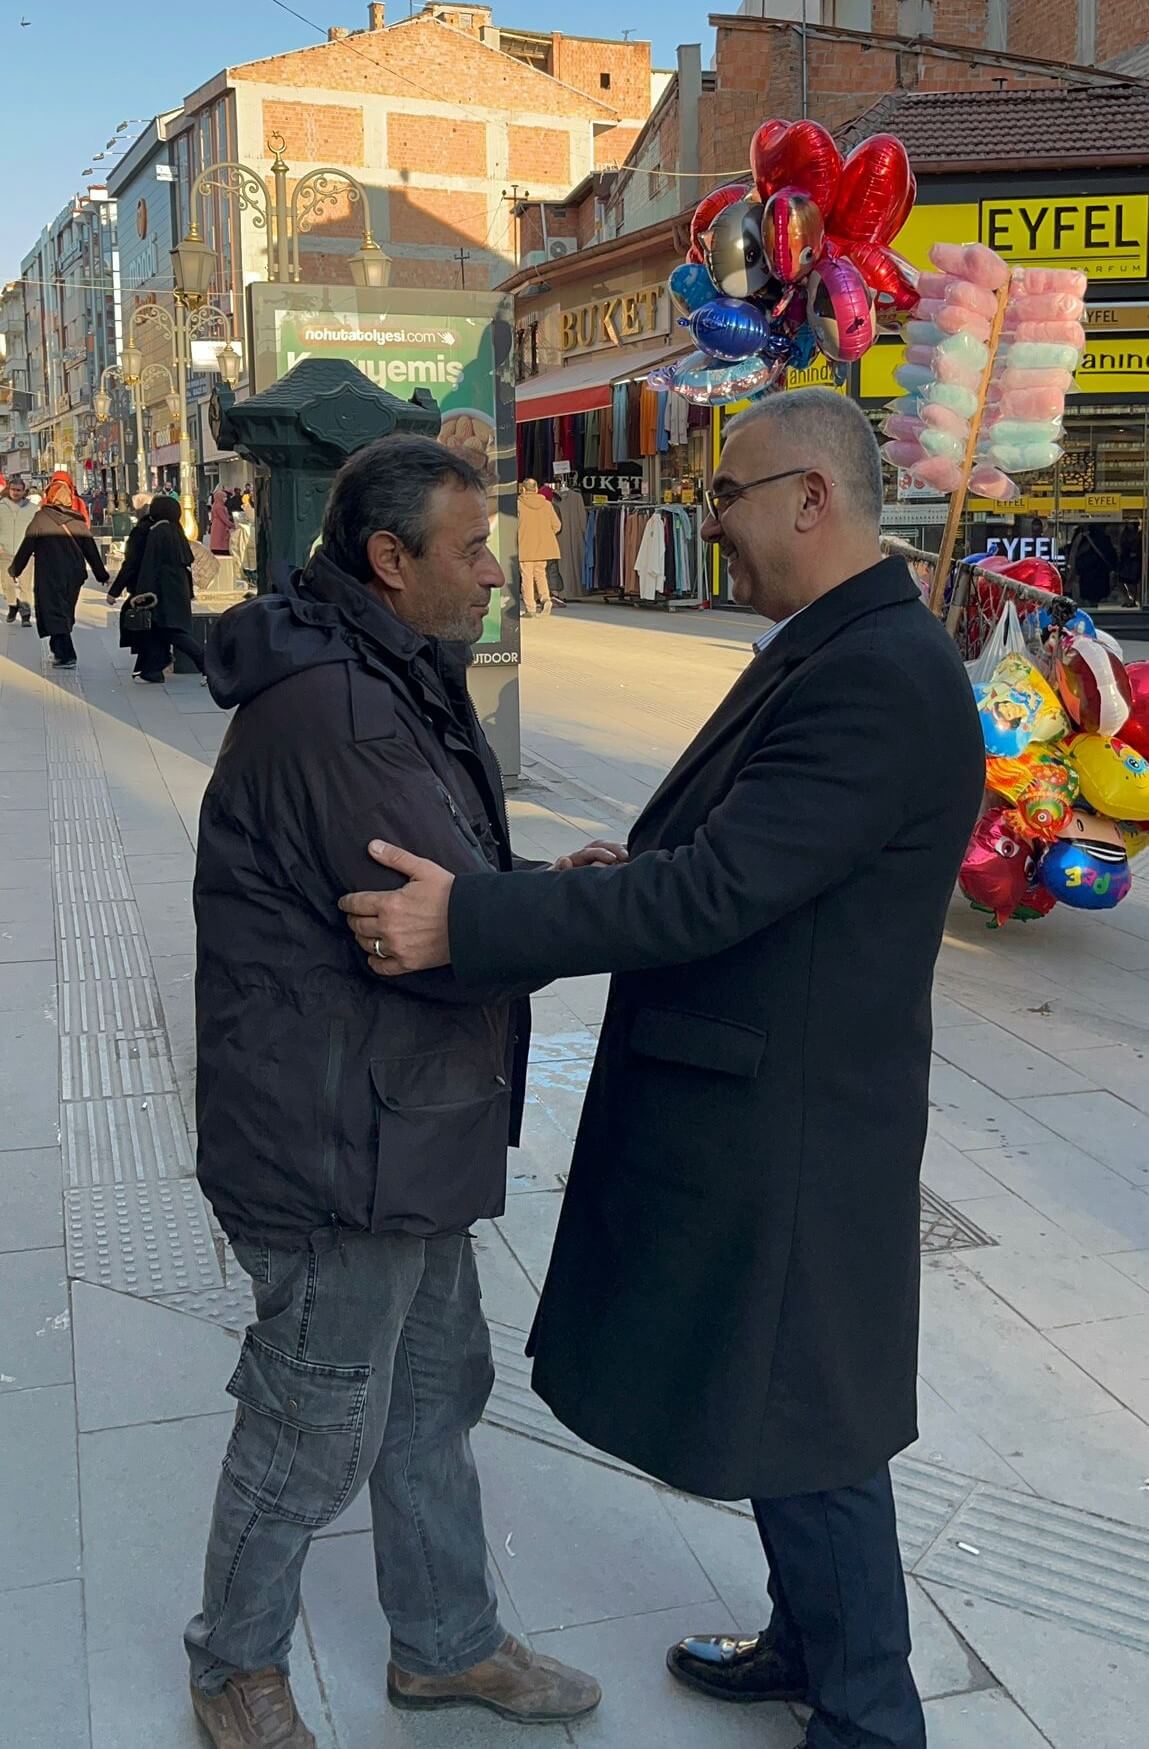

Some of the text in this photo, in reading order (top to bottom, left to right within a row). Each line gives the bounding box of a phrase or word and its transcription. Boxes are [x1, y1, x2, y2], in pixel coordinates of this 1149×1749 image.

[989, 204, 1141, 251] EYFEL
[560, 286, 664, 349] BUKET
[1087, 309, 1119, 323] YFEL
[305, 328, 436, 345] nohutatolyesi.com
[287, 351, 464, 392] Kyemiş
[1088, 495, 1117, 505] EYFEL
[473, 652, 518, 664] UTDOOR
